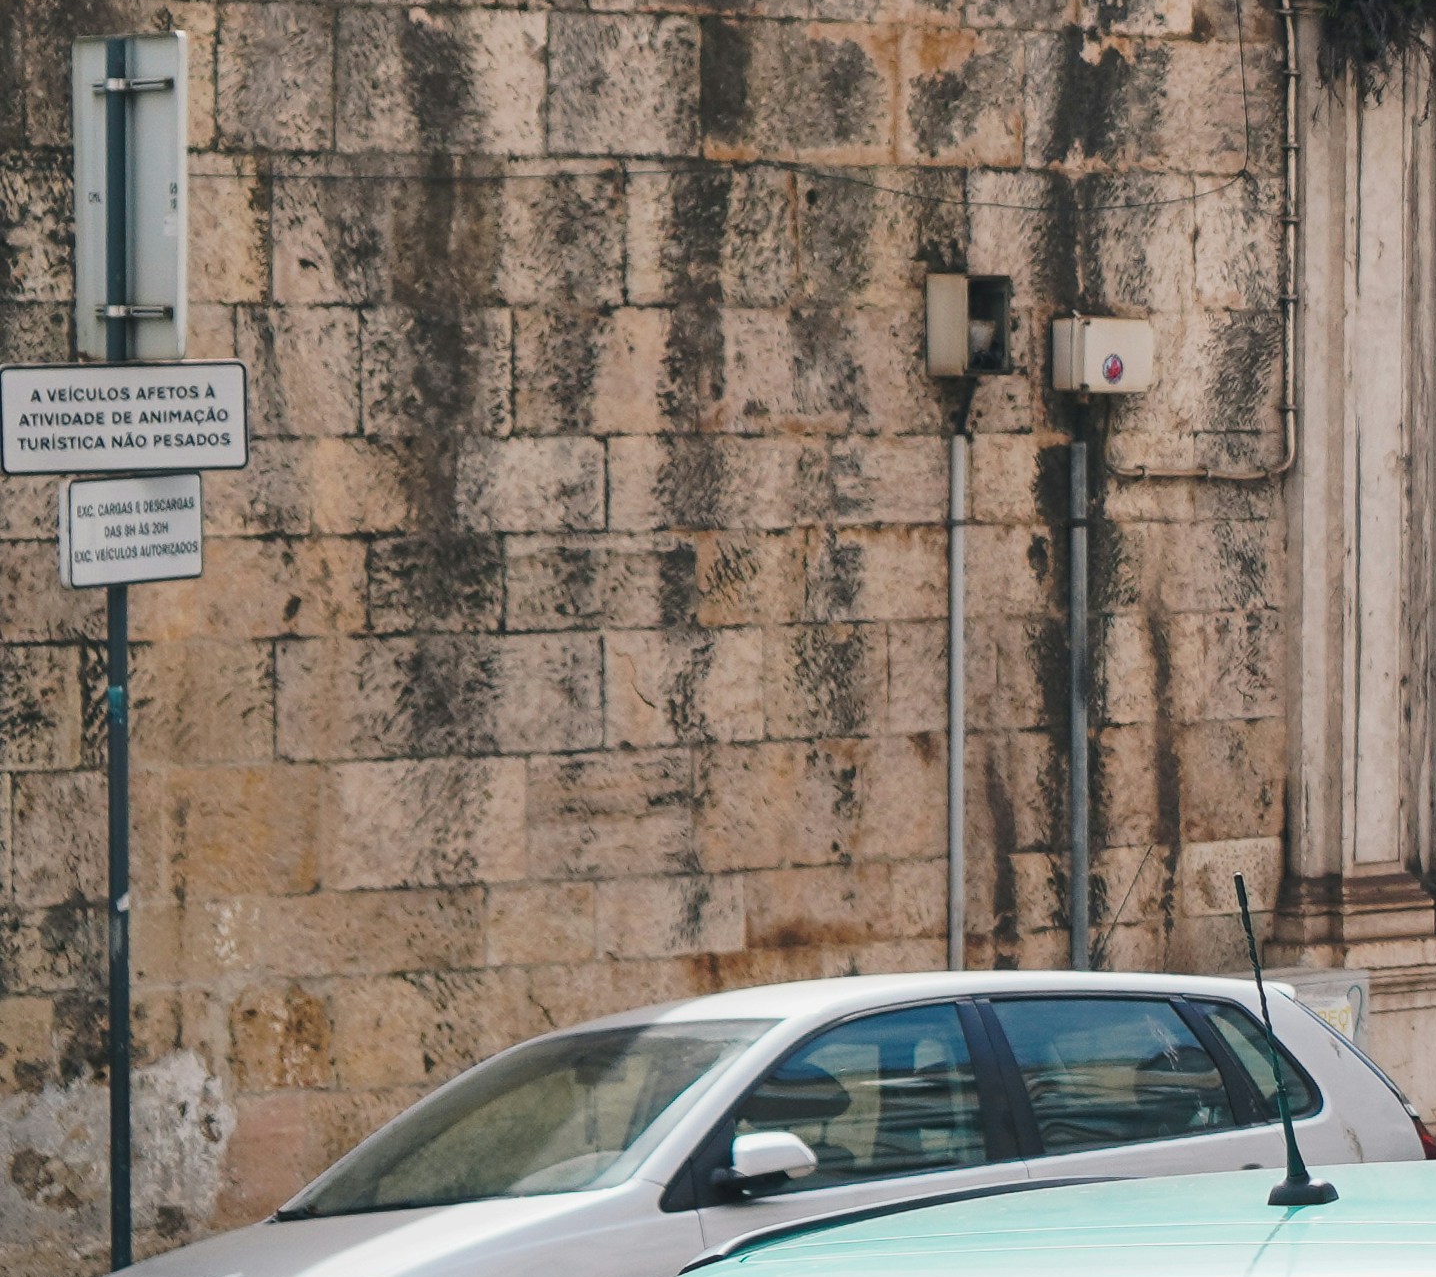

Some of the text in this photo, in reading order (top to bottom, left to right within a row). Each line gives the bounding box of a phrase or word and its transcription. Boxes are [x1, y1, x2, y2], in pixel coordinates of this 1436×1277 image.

[30, 382, 216, 403] A VEÍCULOS AFETOS À
[18, 406, 229, 427] ATIVIDADE DE ANIMAÇÃO
[17, 431, 231, 451] TURÍSTICA NÃO PESADOS
[98, 500, 133, 517] CARGAS
[143, 496, 195, 514] DESCARGAS
[104, 524, 122, 539] DAS
[152, 521, 169, 535] 20H
[95, 545, 138, 562] VEÍCULOS
[140, 541, 199, 558] AUTORIZADOS
